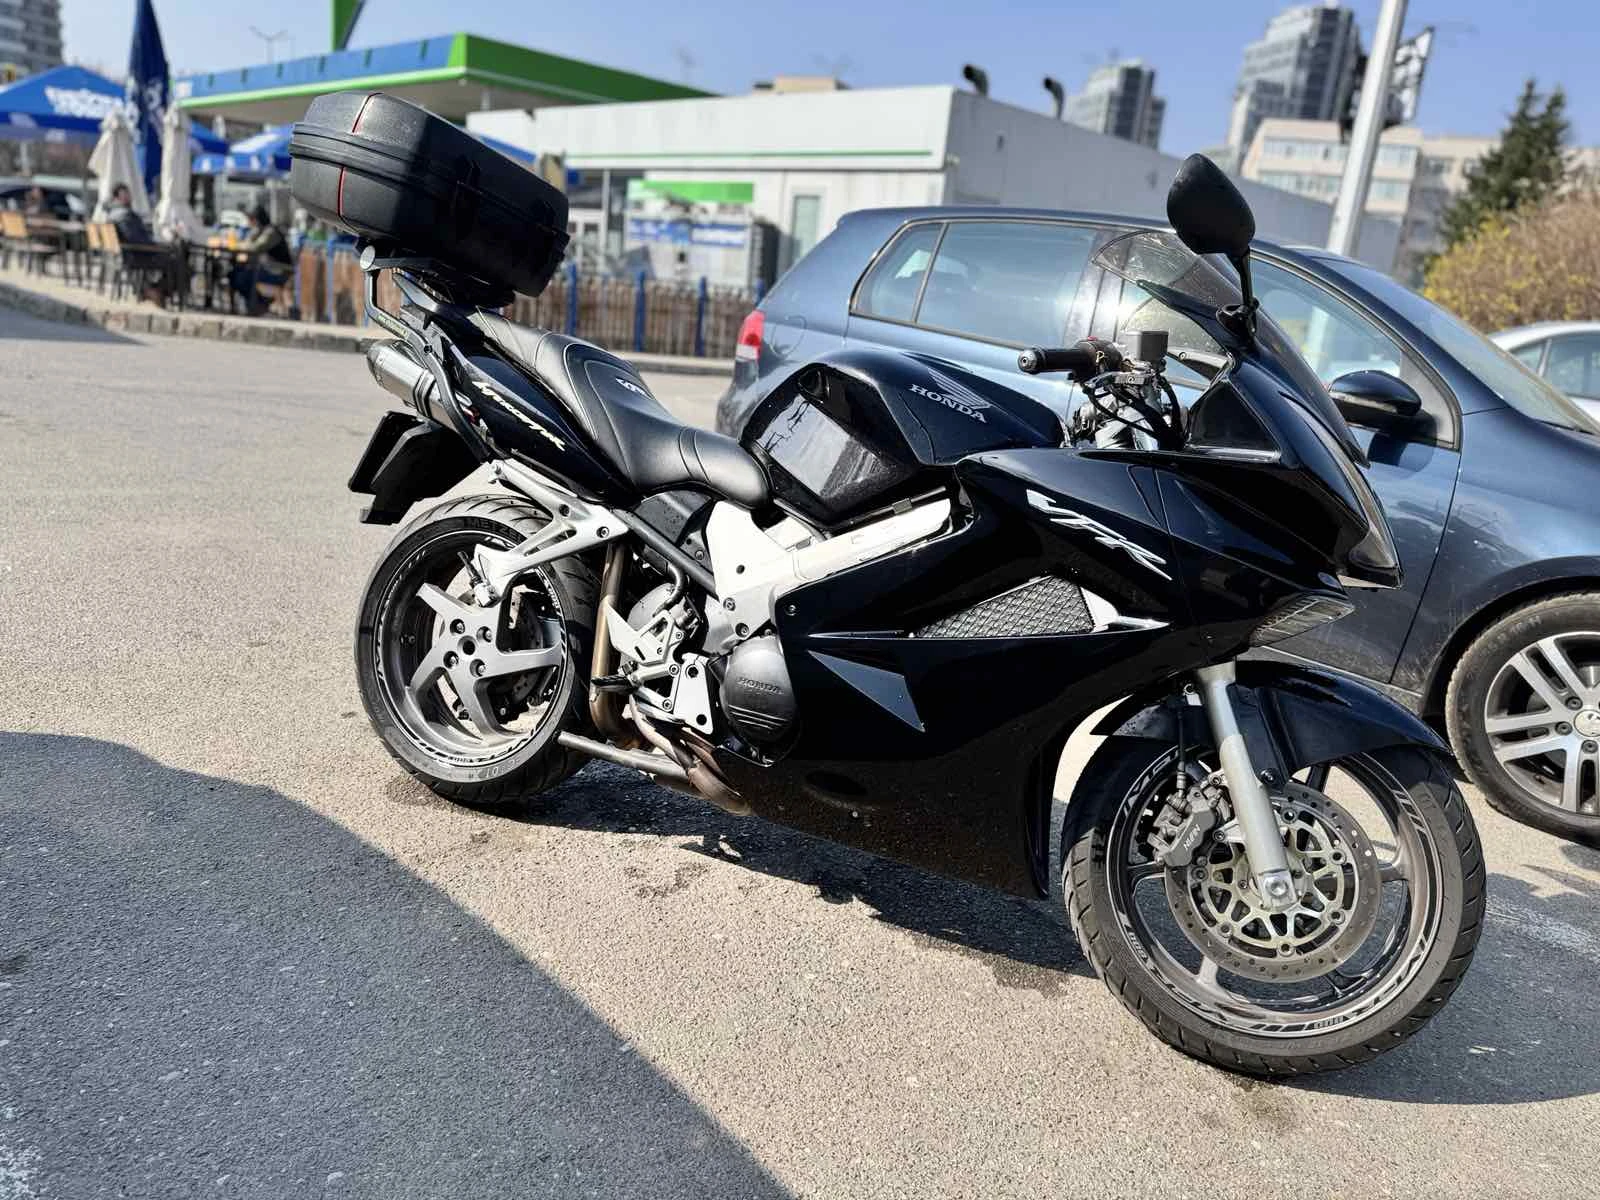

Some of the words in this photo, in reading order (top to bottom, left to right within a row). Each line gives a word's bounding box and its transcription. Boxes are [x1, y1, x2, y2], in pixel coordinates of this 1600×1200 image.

[908, 383, 987, 423] HONDA
[1026, 489, 1173, 581] VFR
[737, 677, 785, 695] HONDA
